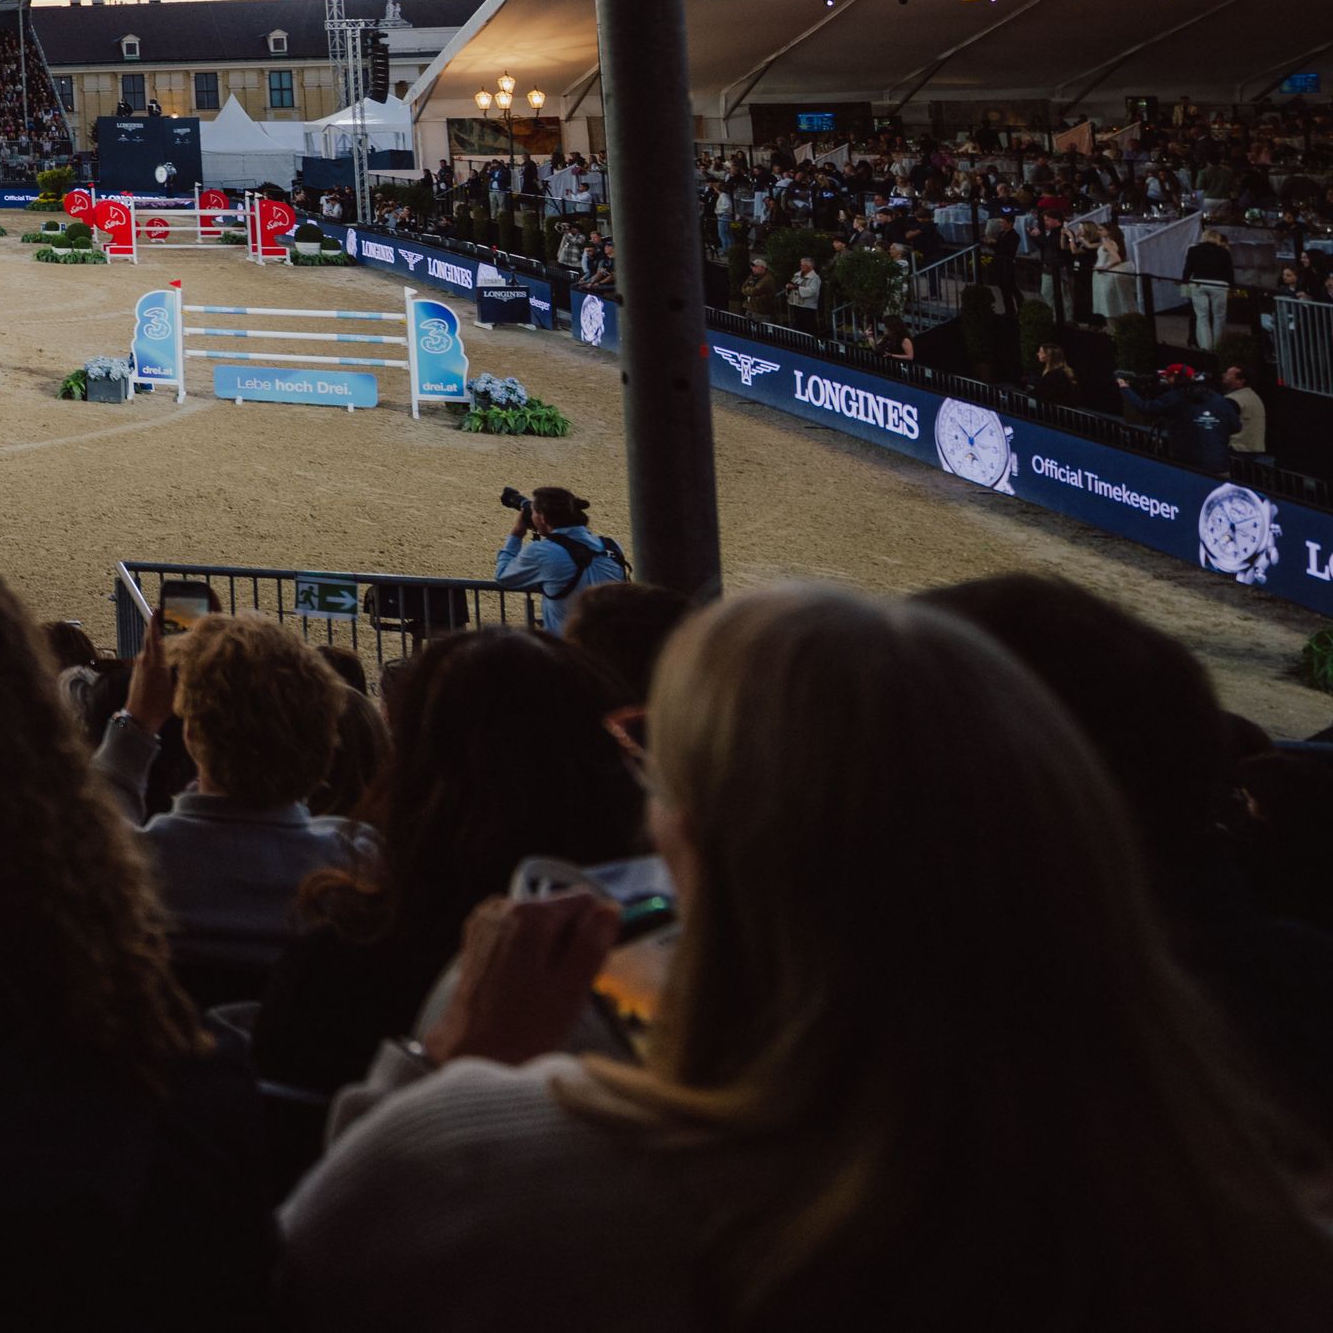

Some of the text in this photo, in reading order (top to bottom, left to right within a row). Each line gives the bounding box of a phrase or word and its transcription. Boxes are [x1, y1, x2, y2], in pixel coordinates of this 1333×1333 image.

[361, 240, 395, 264] LONGINES
[427, 257, 473, 290] LONGINES
[483, 290, 527, 298] LONGINES
[142, 366, 173, 376] drei.at
[237, 377, 353, 395] Lebe hoch Drei.
[422, 382, 457, 392] drei.at
[793, 370, 919, 440] LONGINES
[1031, 454, 1179, 520] Official Timekeeper
[1305, 540, 1333, 582] L
